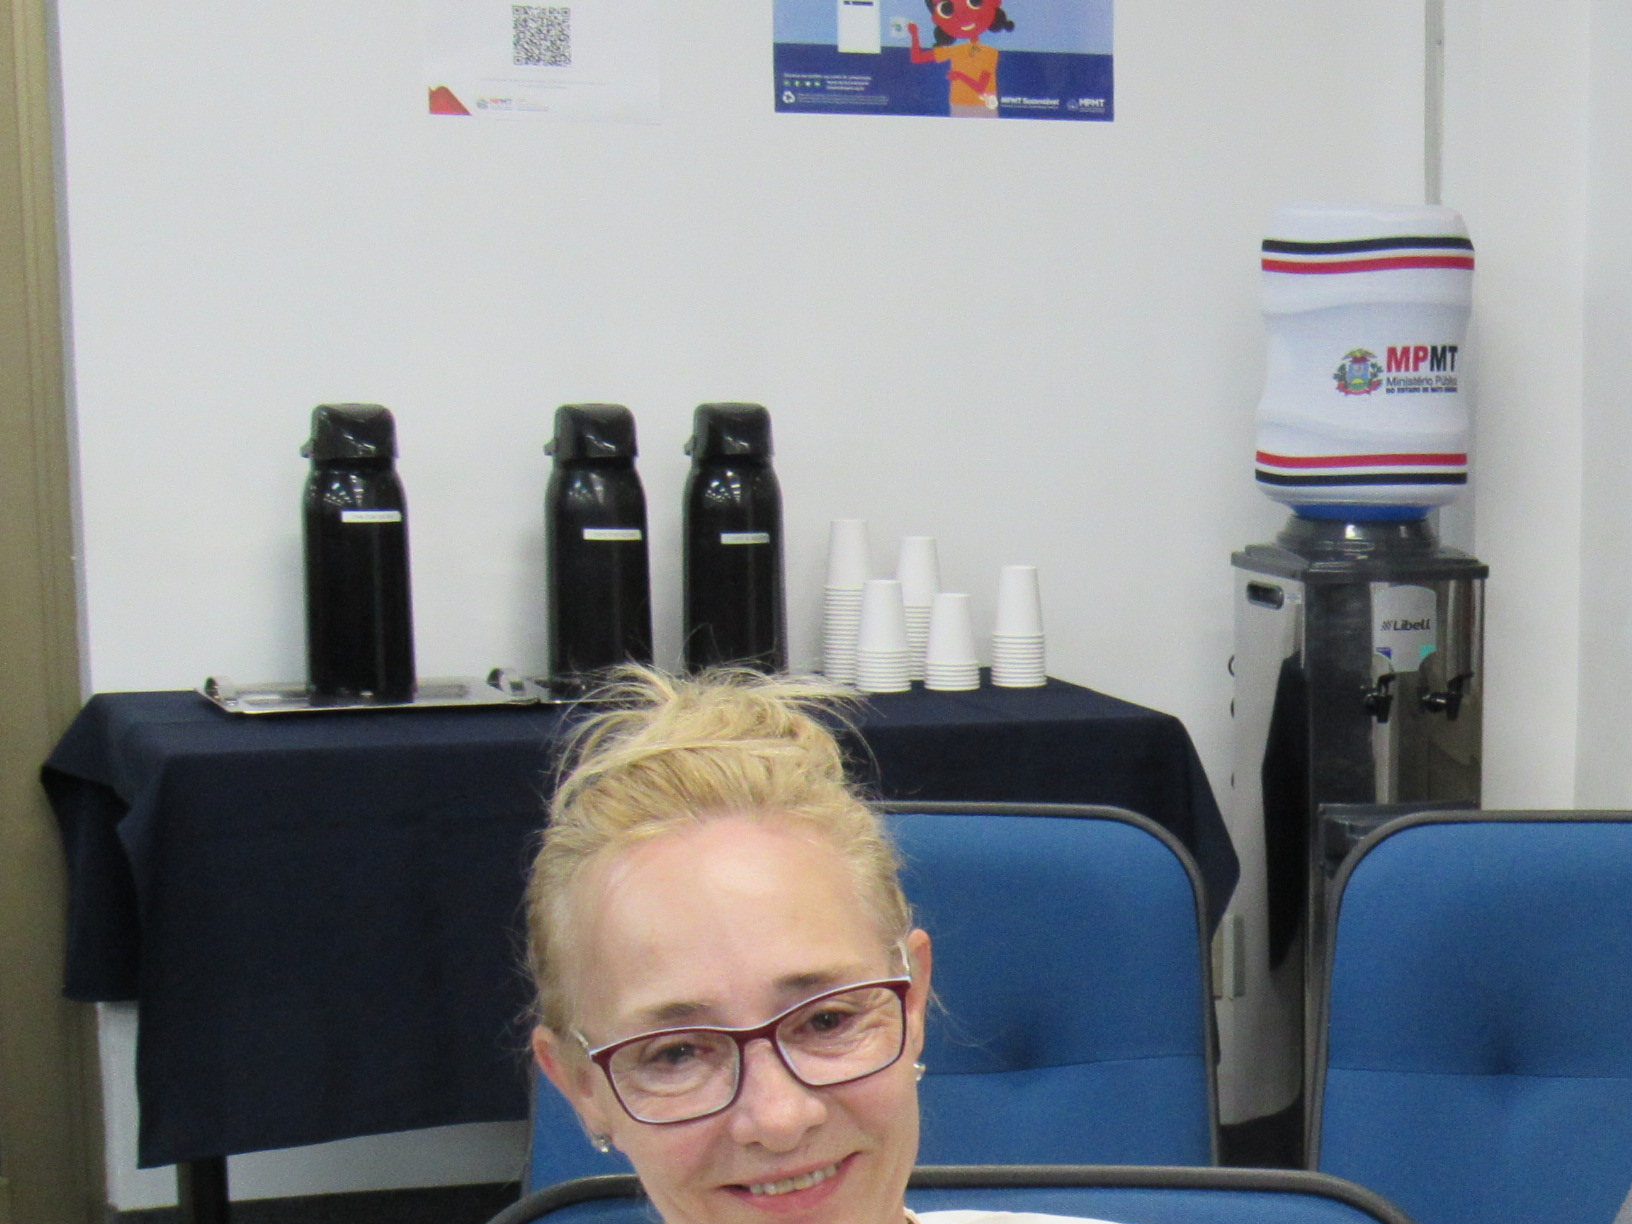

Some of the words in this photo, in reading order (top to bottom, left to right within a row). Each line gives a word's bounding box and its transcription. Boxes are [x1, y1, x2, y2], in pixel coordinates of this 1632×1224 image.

[1079, 98, 1105, 107] MPMT
[1387, 345, 1458, 372] MPMT
[1386, 376, 1433, 387] Ministério
[1393, 617, 1431, 632] Libell
